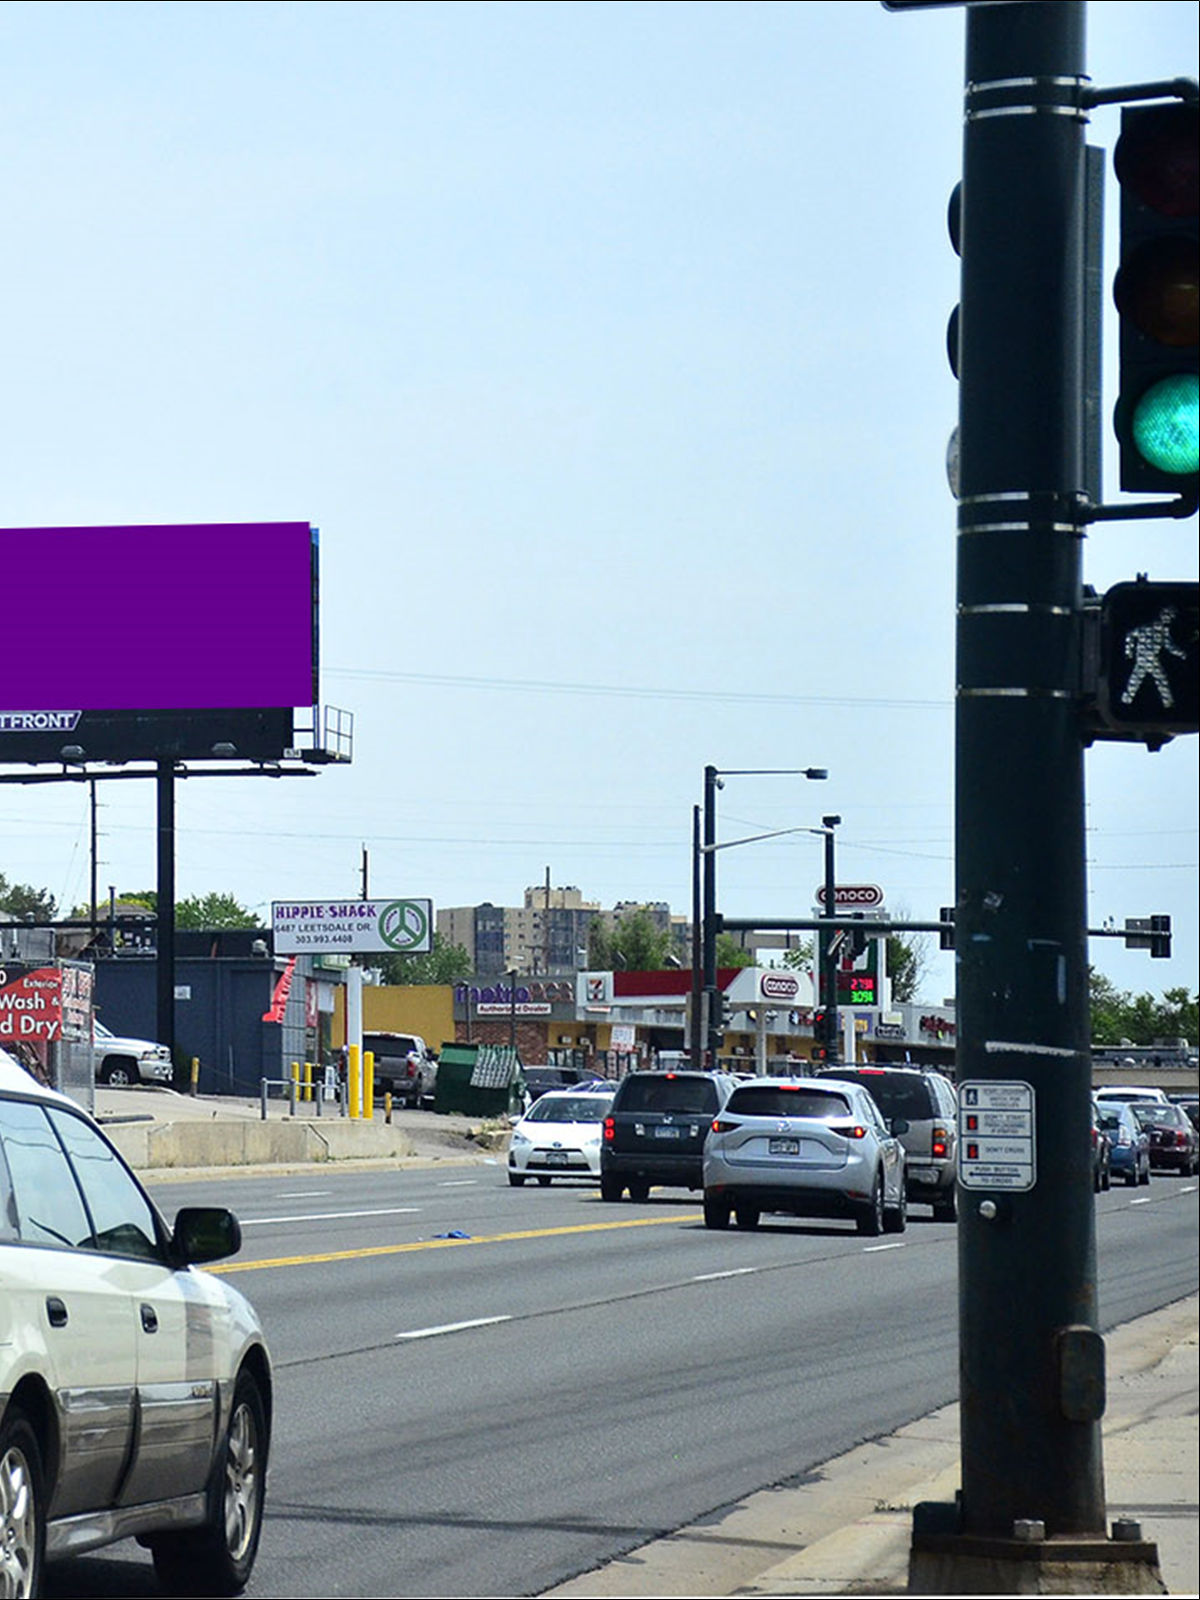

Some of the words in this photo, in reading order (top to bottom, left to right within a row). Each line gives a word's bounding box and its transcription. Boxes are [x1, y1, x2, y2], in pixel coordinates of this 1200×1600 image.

[275, 905, 325, 919] HIPPIE
[328, 904, 377, 918] SHACK
[22, 978, 59, 989] Exterior
[50, 996, 60, 1007] &
[20, 1014, 59, 1040] Dry
